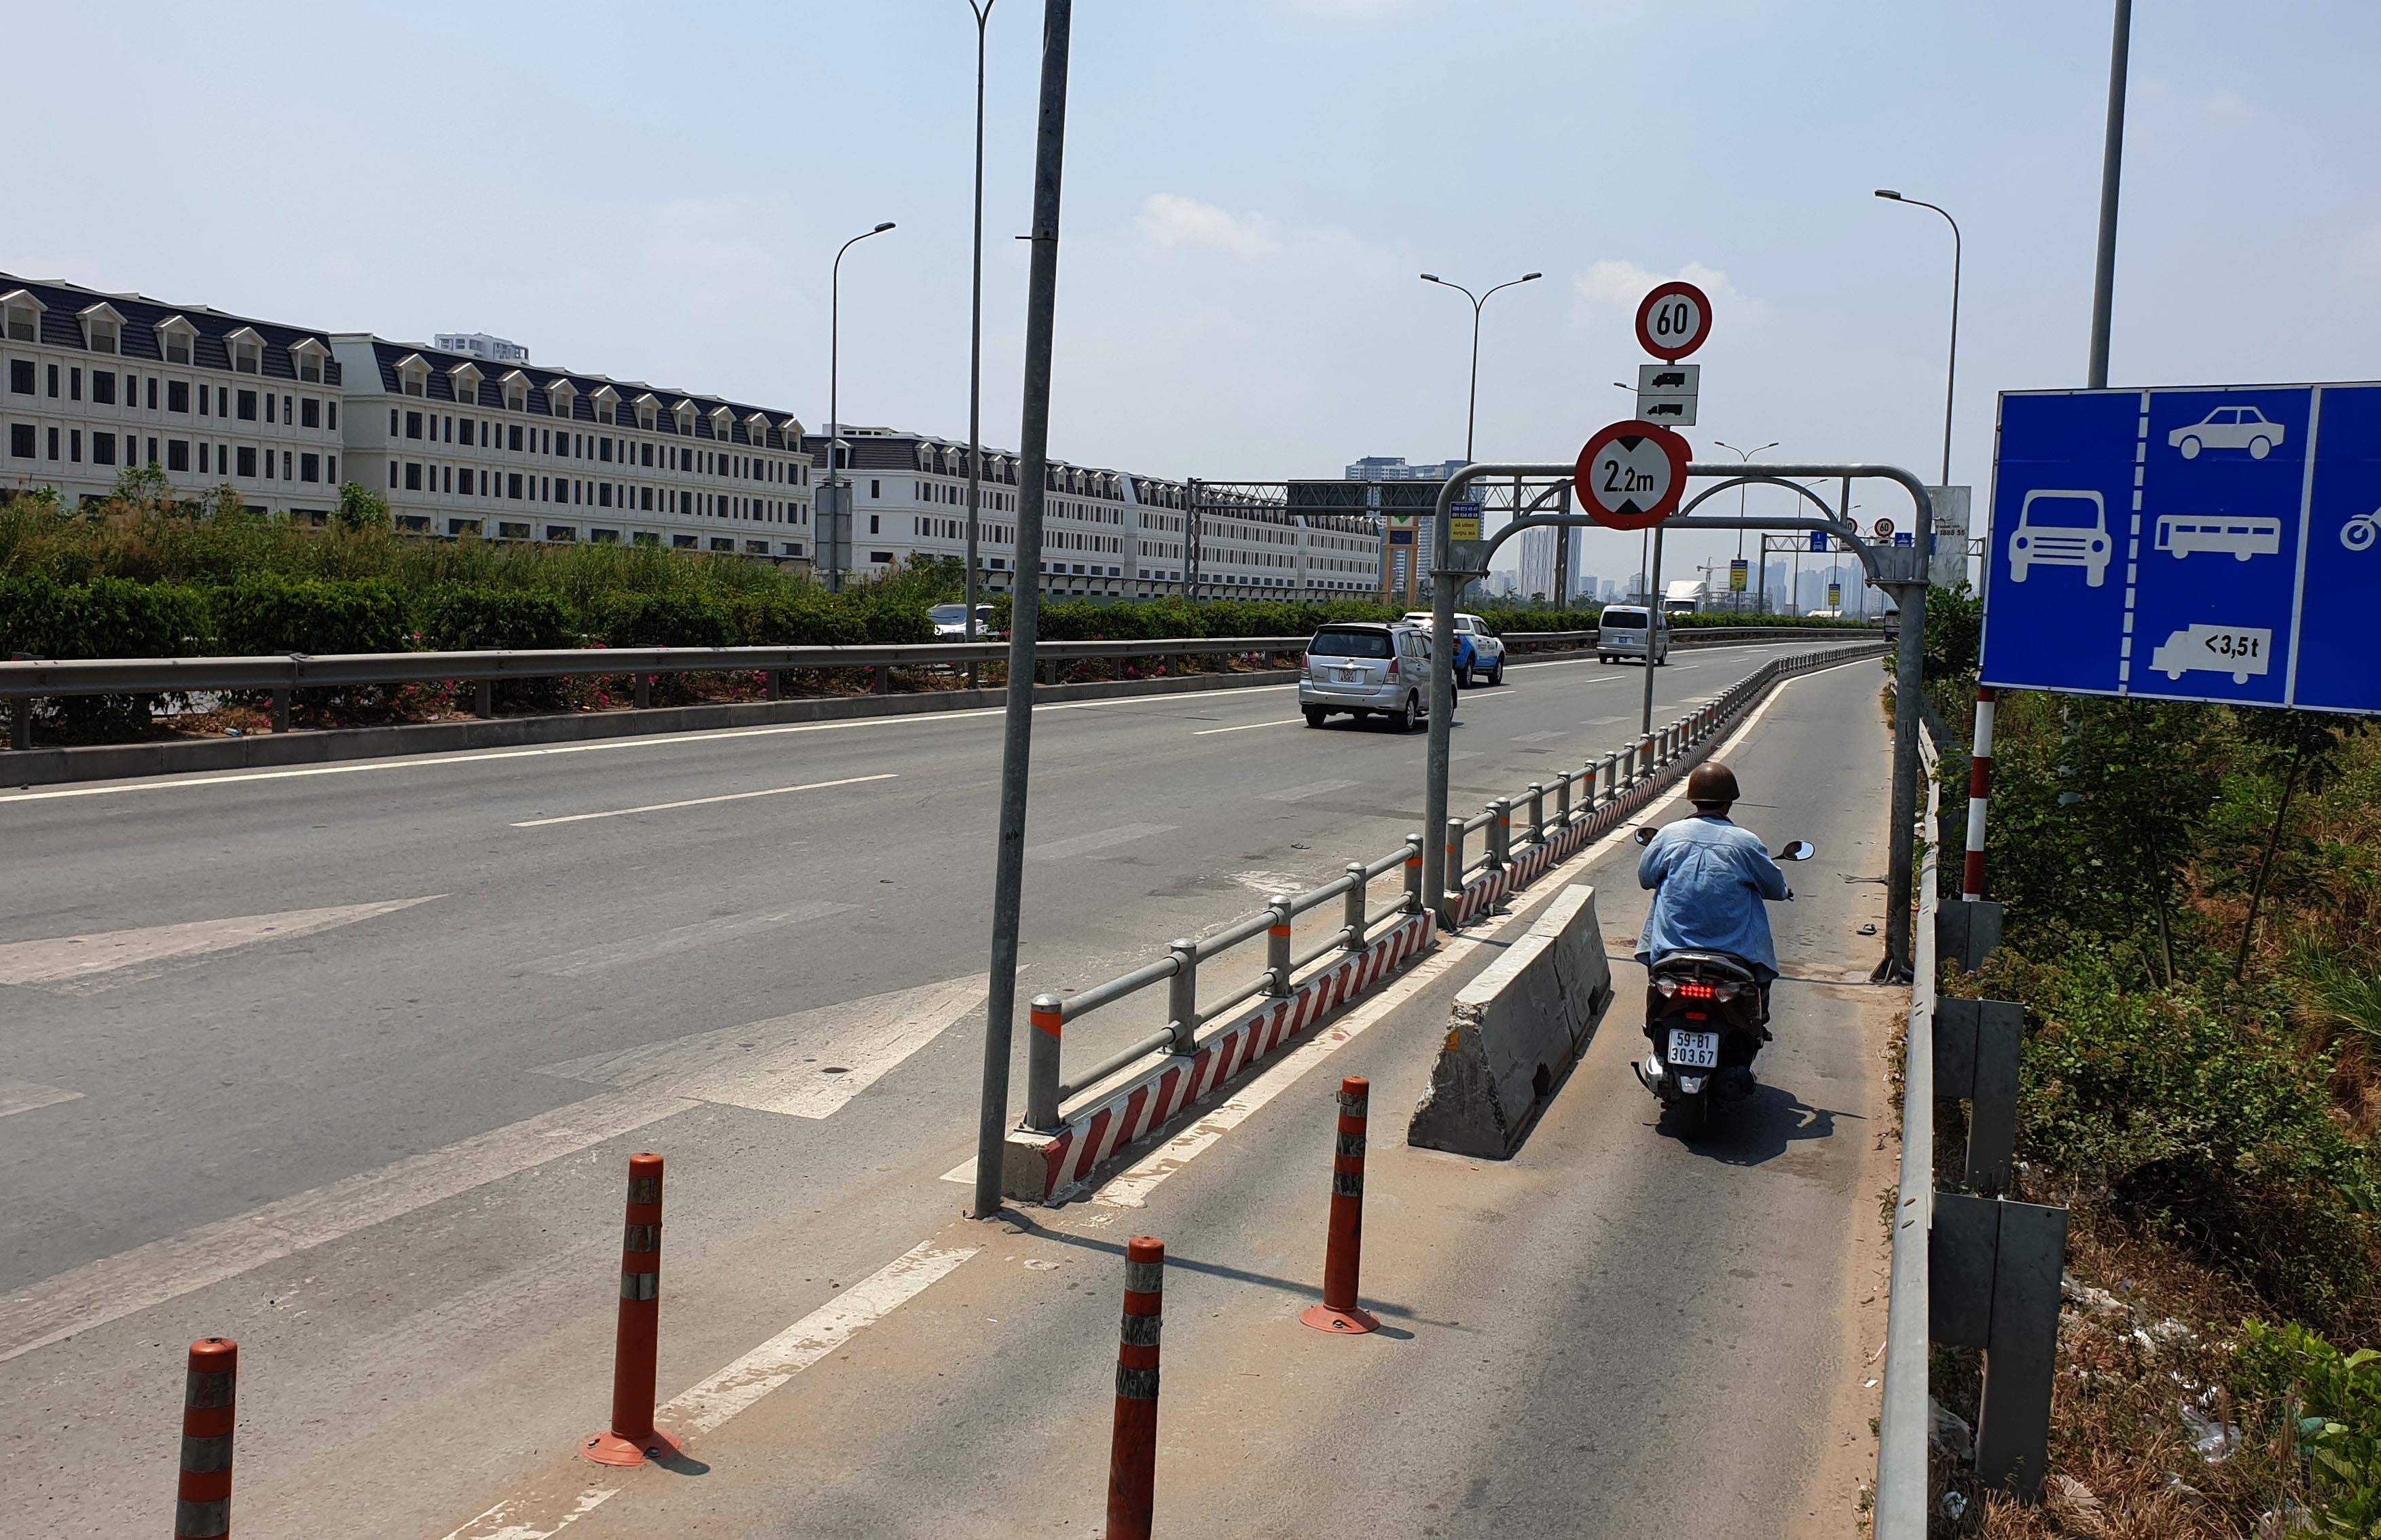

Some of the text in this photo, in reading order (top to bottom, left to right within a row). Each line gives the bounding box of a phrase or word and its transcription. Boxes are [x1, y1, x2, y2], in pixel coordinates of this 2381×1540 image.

[1656, 303, 1688, 335] 60
[1603, 460, 1654, 492] 2.2m
[1880, 522, 1889, 532] 60
[1677, 1032, 1709, 1049] 59-B1
[1671, 1047, 1714, 1065] 303.67
